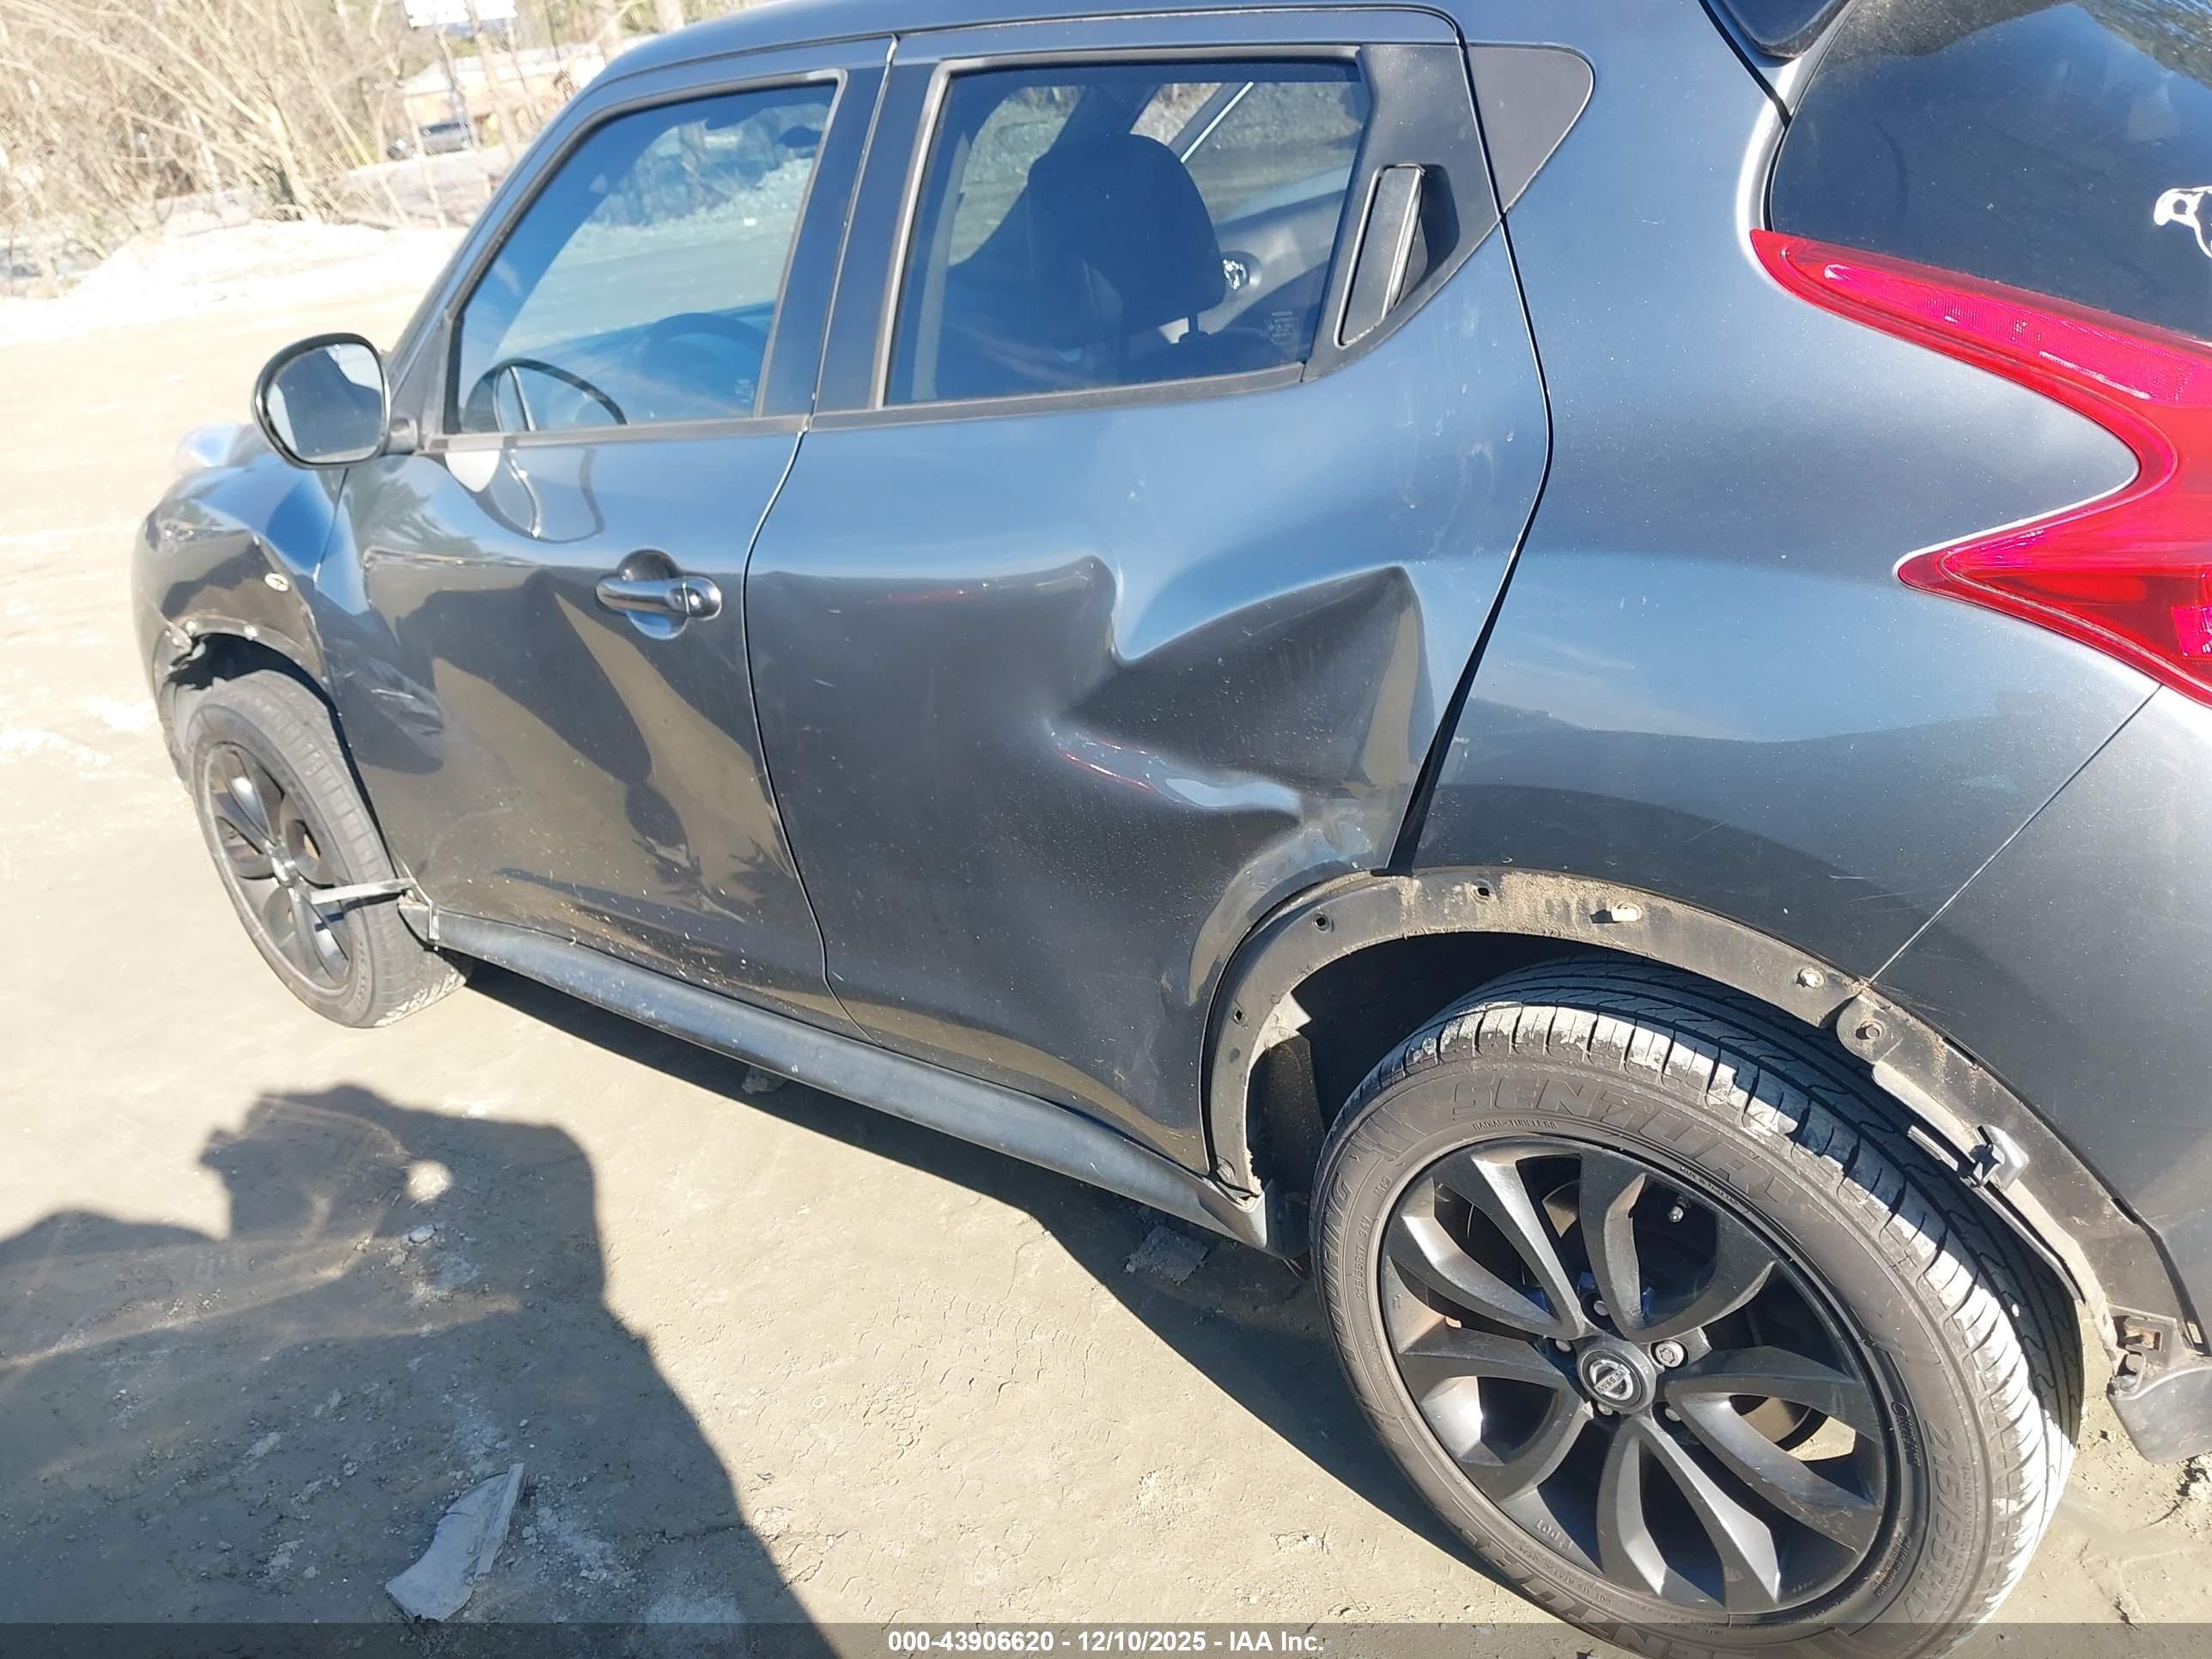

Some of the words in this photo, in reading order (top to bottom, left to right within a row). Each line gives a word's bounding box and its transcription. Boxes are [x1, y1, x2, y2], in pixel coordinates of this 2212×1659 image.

[1323, 1170, 1359, 1363] TOURING
[1354, 1243, 1369, 1301] 215/55R17
[1903, 1419, 1963, 1625] 215/55R17
